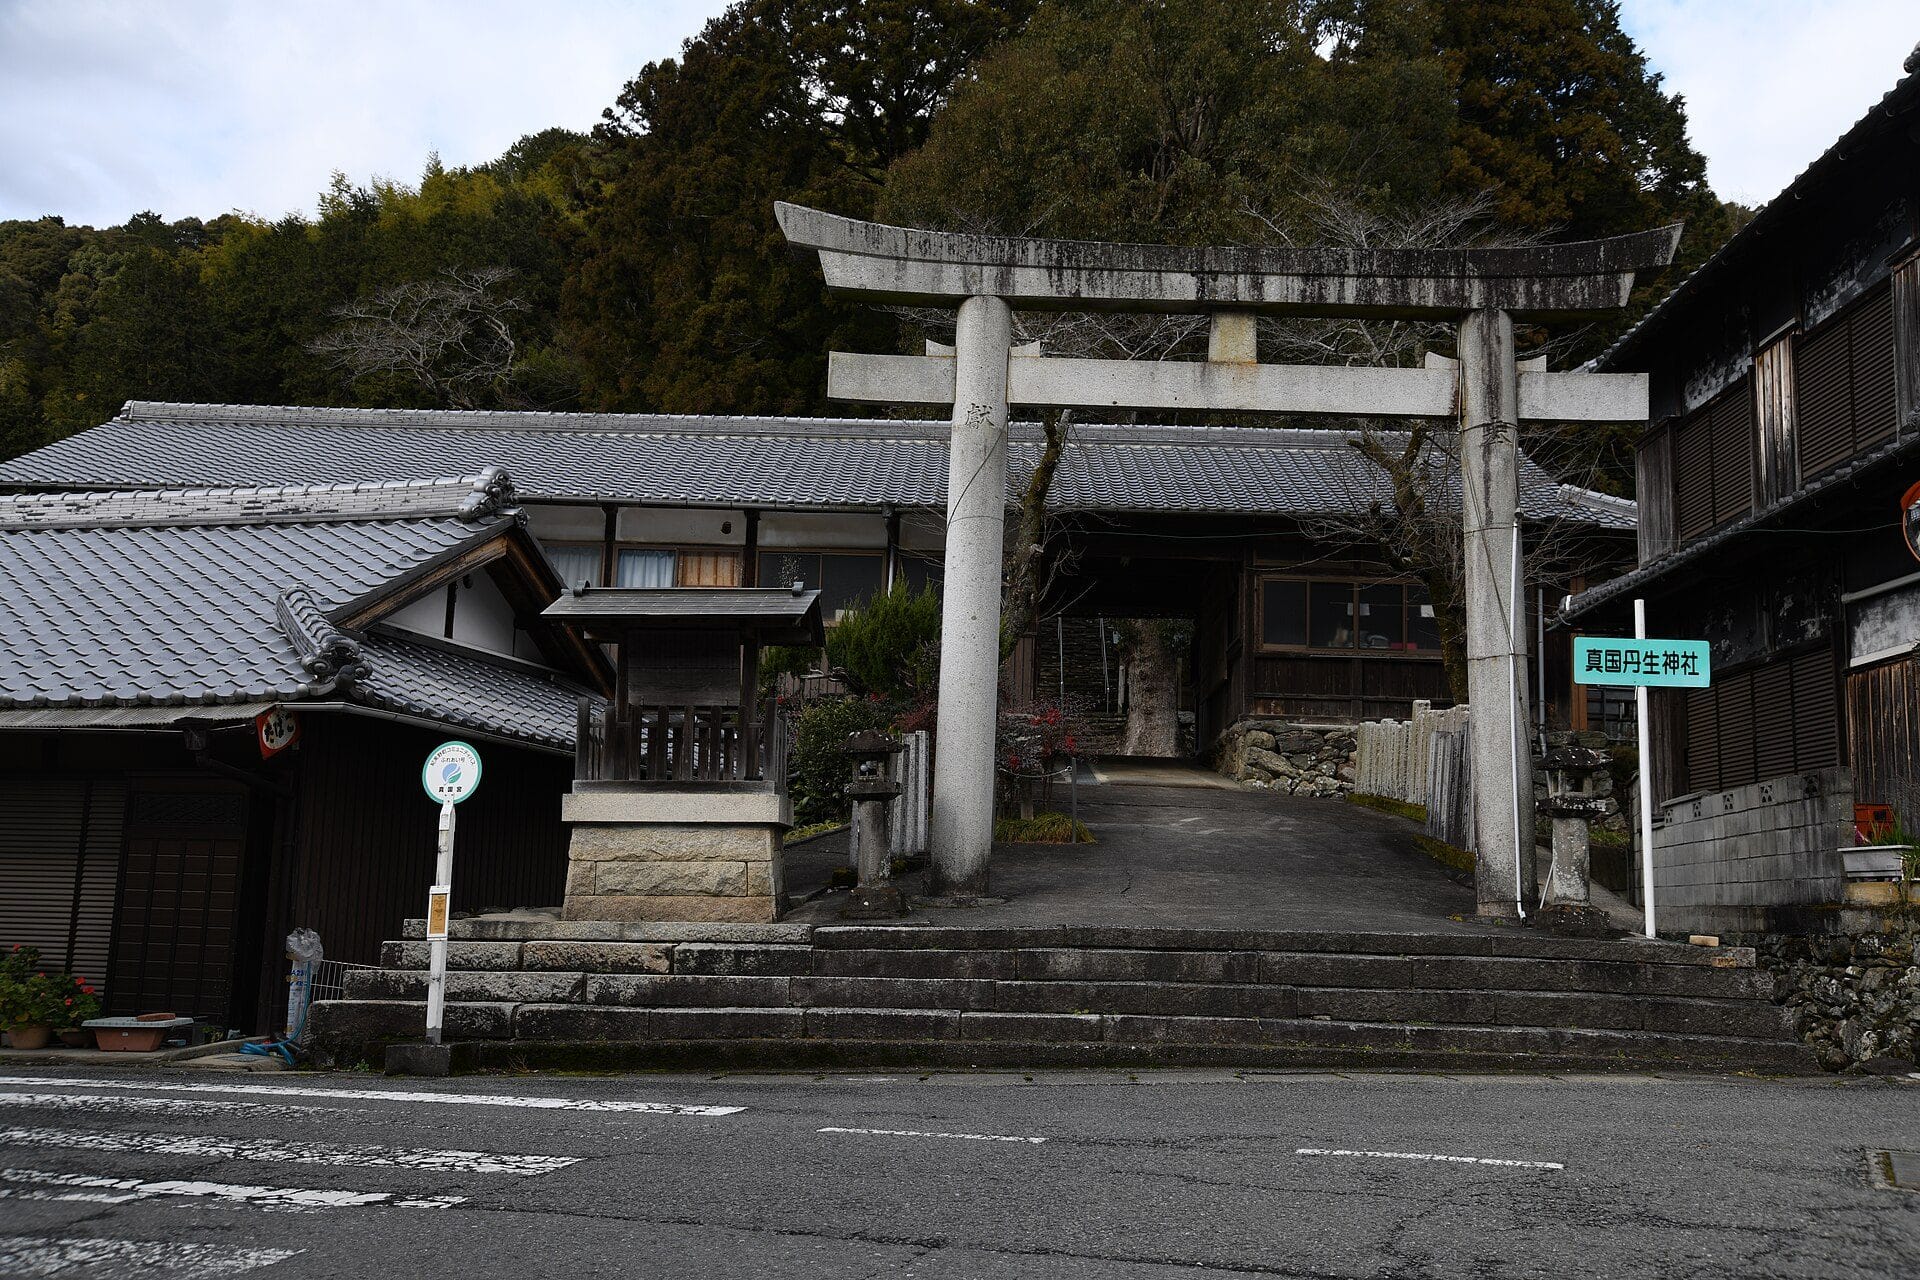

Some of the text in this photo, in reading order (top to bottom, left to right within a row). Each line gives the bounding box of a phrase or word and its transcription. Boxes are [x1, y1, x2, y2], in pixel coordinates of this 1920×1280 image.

[1585, 648, 1700, 676] 真国丹生神社
